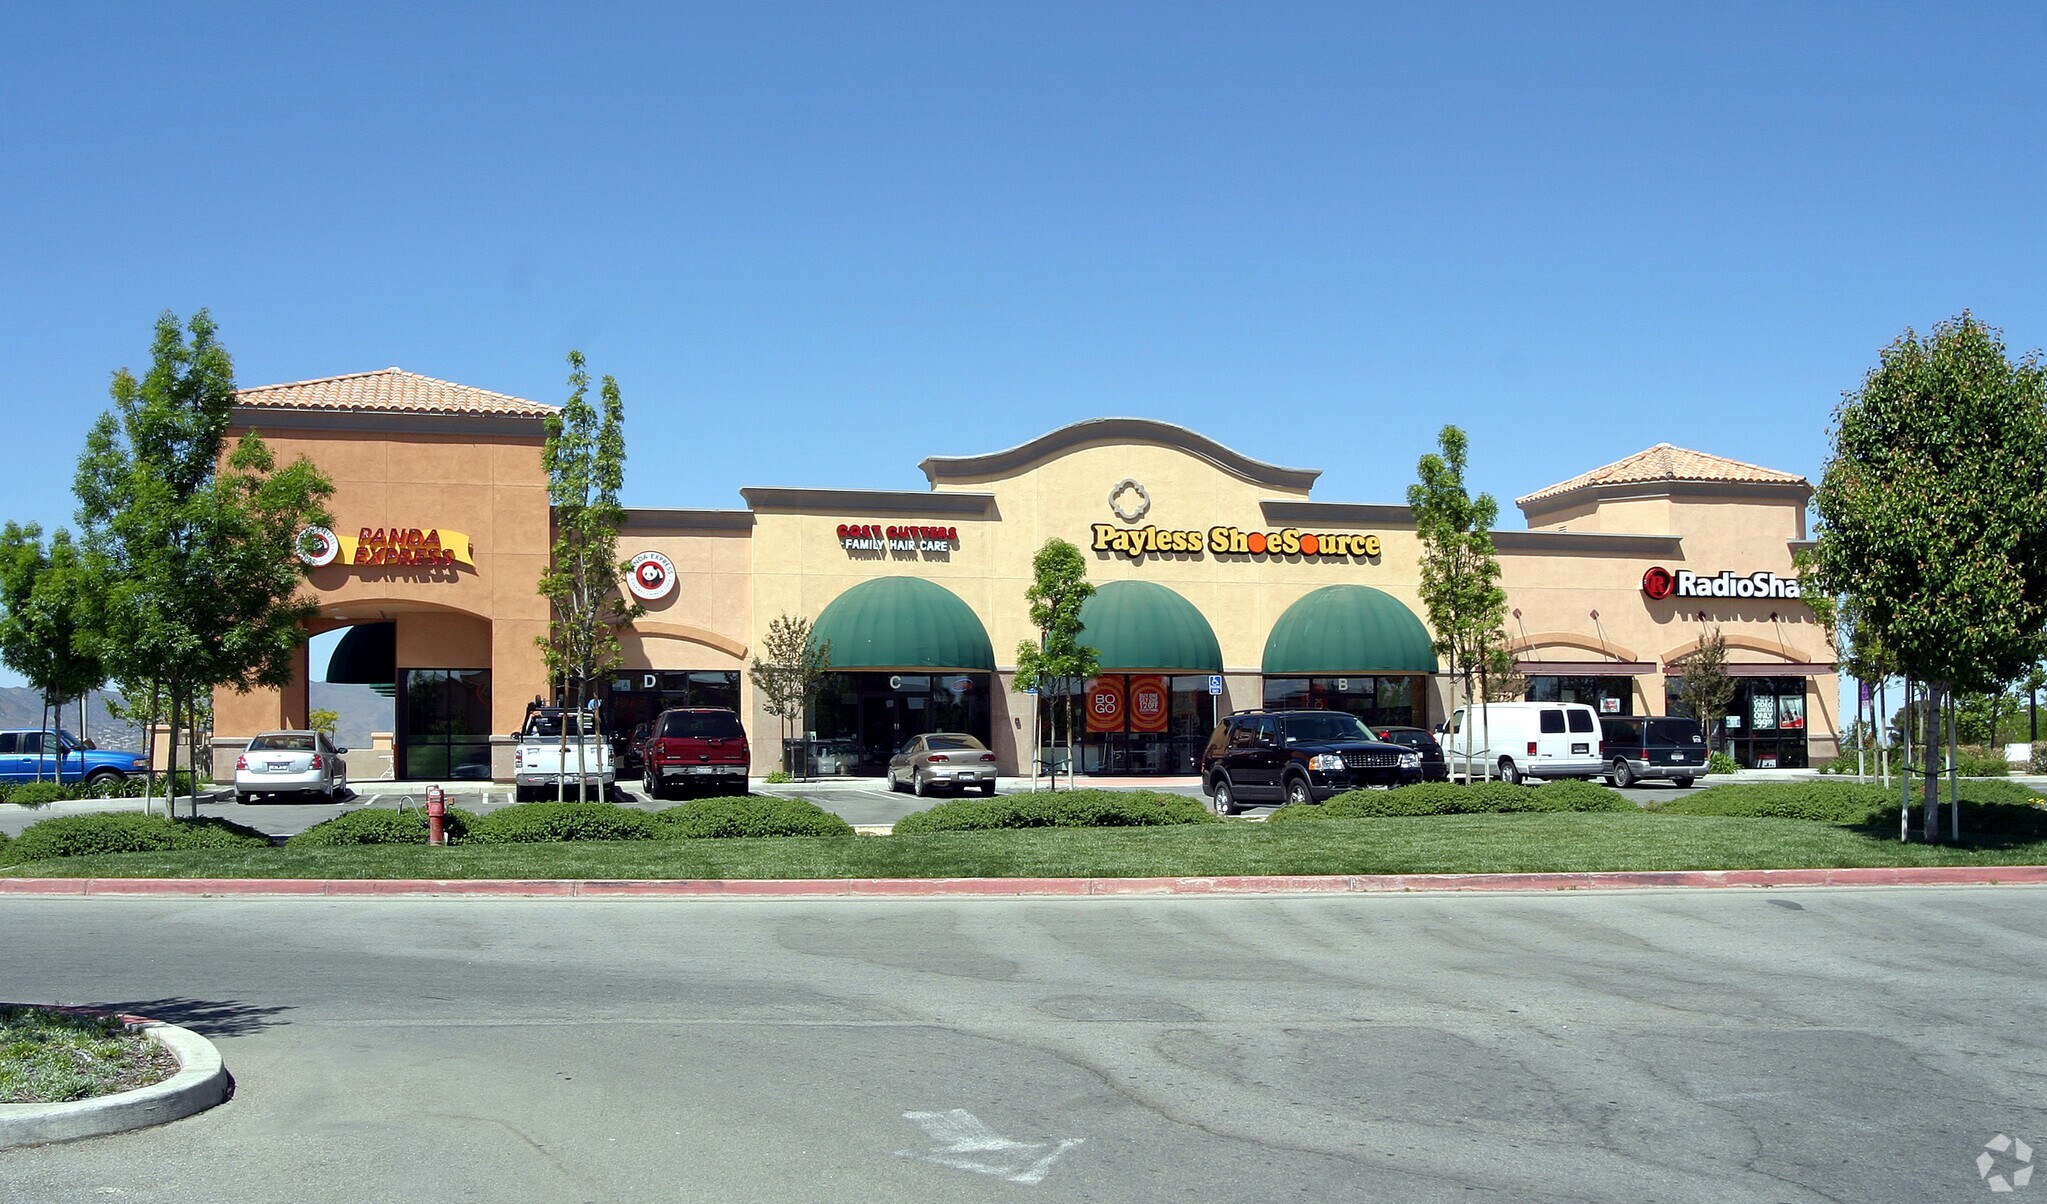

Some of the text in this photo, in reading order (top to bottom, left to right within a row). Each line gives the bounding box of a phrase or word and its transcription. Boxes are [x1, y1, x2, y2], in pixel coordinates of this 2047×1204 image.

[358, 527, 440, 546] PANDA
[836, 524, 956, 540] COST CUTTERS
[845, 539, 947, 551] FAMILY HAIR CARE
[1092, 525, 1380, 556] Payless ShoeSource
[354, 547, 455, 566] EXPRESS
[650, 553, 674, 575] EXPRESS
[1678, 571, 1829, 598] RadioSha
[644, 674, 656, 688] D
[889, 675, 901, 689] C
[1338, 678, 1348, 691] B
[1095, 694, 1115, 704] BO
[1095, 703, 1116, 714] GO
